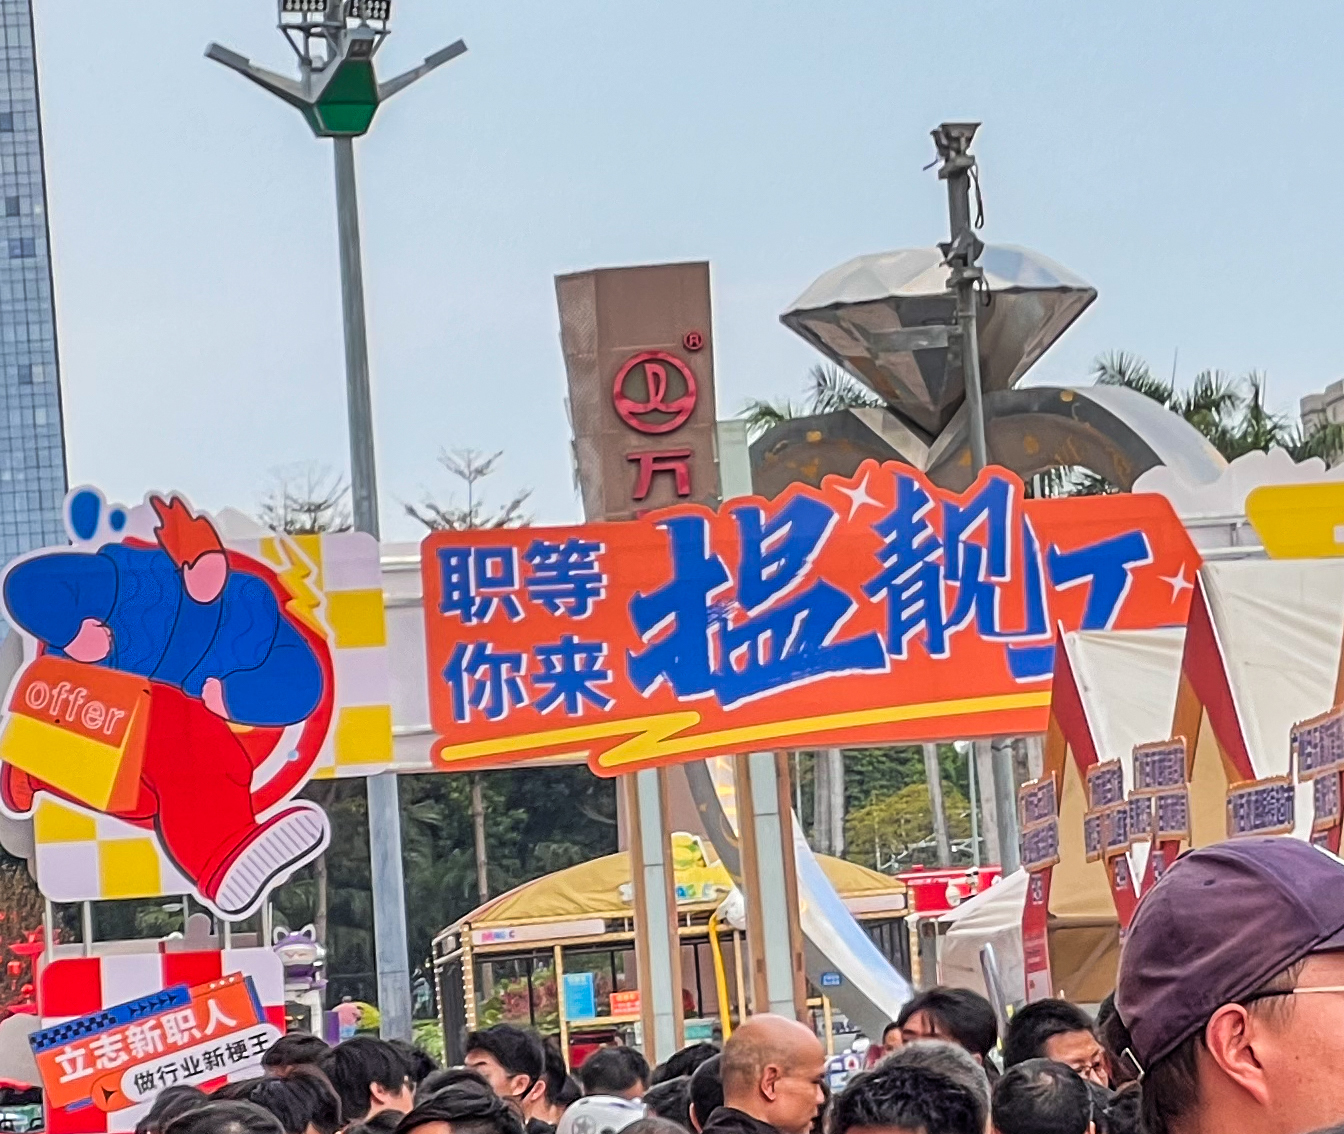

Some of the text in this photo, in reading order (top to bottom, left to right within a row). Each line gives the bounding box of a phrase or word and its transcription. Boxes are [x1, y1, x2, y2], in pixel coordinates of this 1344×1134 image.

[626, 451, 691, 517] 万
[436, 537, 608, 625] 职等
[25, 680, 125, 735] offer
[442, 634, 617, 722] 你来
[55, 998, 237, 1083] 立志新职人
[133, 1031, 269, 1095] 做行业新梗王
